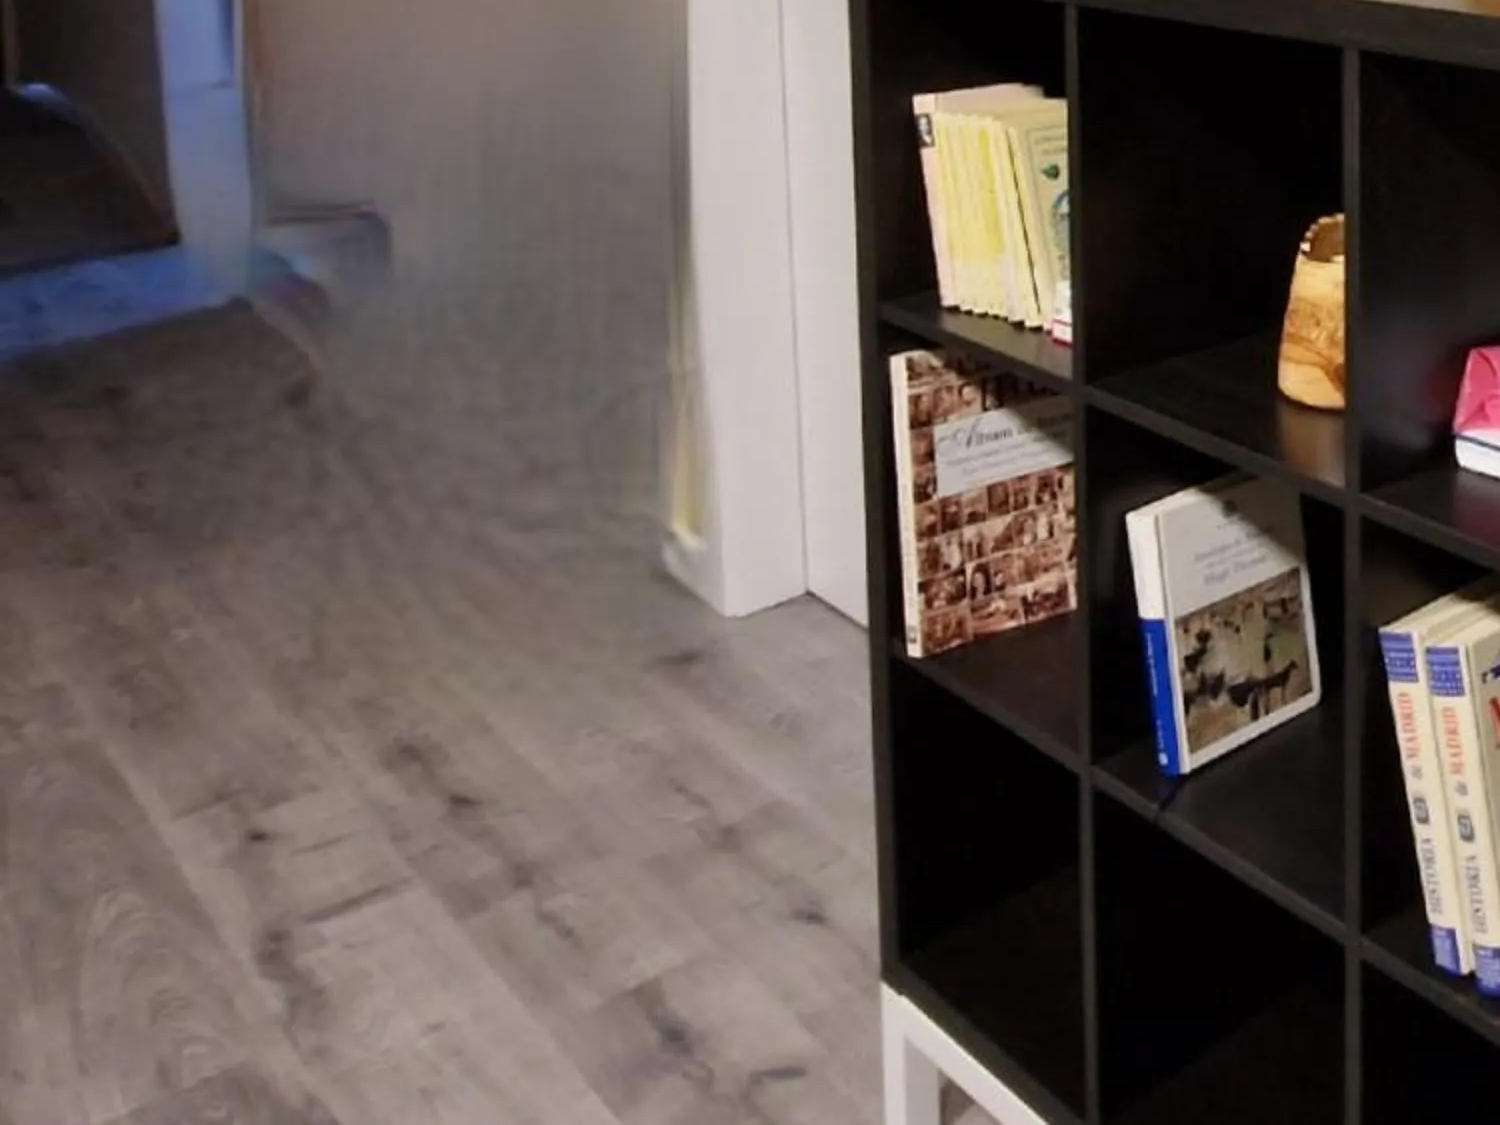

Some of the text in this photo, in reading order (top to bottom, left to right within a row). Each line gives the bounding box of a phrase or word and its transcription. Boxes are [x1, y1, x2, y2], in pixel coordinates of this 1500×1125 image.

[1397, 692, 1421, 760] MADRID
[1441, 706, 1465, 775] MADRID
[1420, 837, 1444, 916] HISTORIA
[1464, 854, 1489, 935] HISTORIA
